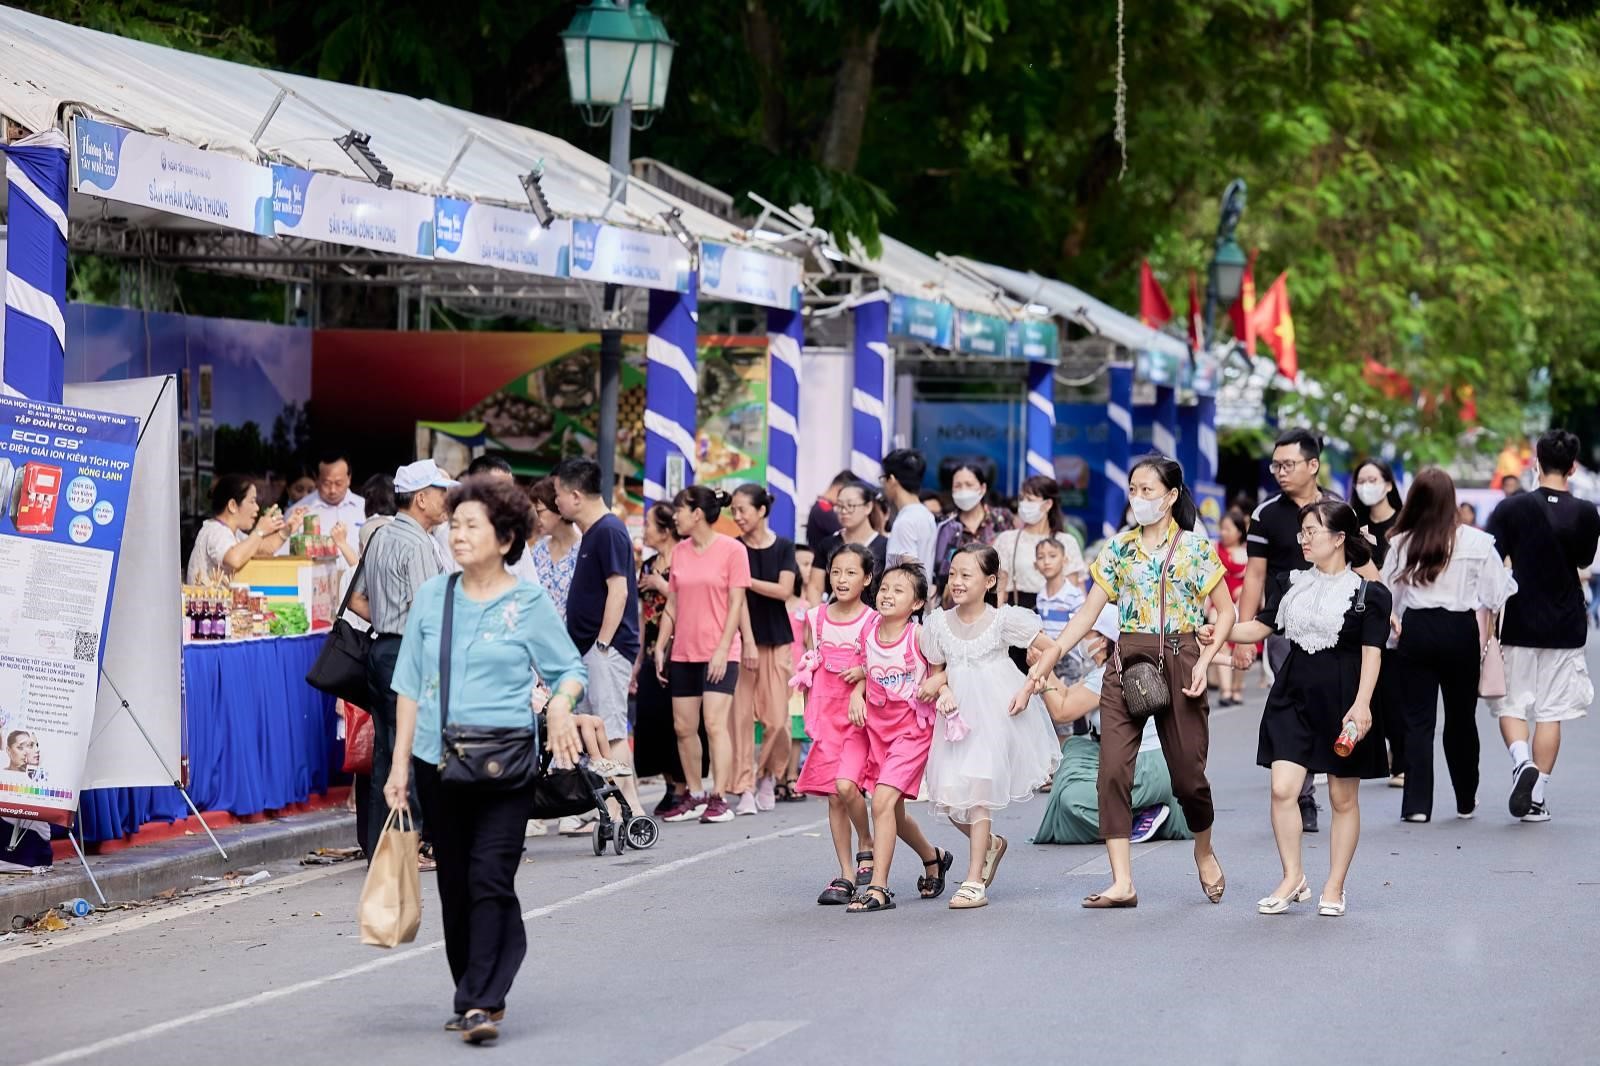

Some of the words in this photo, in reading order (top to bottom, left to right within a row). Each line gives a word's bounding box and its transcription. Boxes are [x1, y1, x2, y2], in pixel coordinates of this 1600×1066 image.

[81, 156, 91, 170] TÂY
[91, 161, 104, 174] NINH
[104, 164, 116, 177] 2023
[149, 177, 163, 203] SẢN
[164, 181, 183, 208] PHẨM
[184, 189, 203, 212] CÔNG
[203, 196, 229, 218] THƯƠNG
[329, 211, 340, 235] SẢN
[13, 400, 28, 409] HỌC
[28, 402, 46, 411] PHÁT
[97, 414, 111, 424] VIỆT
[111, 417, 127, 425] NAM
[15, 414, 32, 425] TẬP
[32, 418, 57, 429] ĐOÀN
[57, 423, 75, 432] ECO
[76, 425, 88, 434] G9
[12, 429, 49, 445] ECO
[9, 442, 30, 455] ĐIỆN
[31, 446, 49, 457] GIẢI
[49, 449, 65, 460] ION
[66, 452, 88, 464] KIỀM
[89, 455, 109, 467] TÍCH
[110, 460, 130, 471] HỢP
[78, 465, 101, 478] NÓNG
[101, 470, 123, 482] LẠNH
